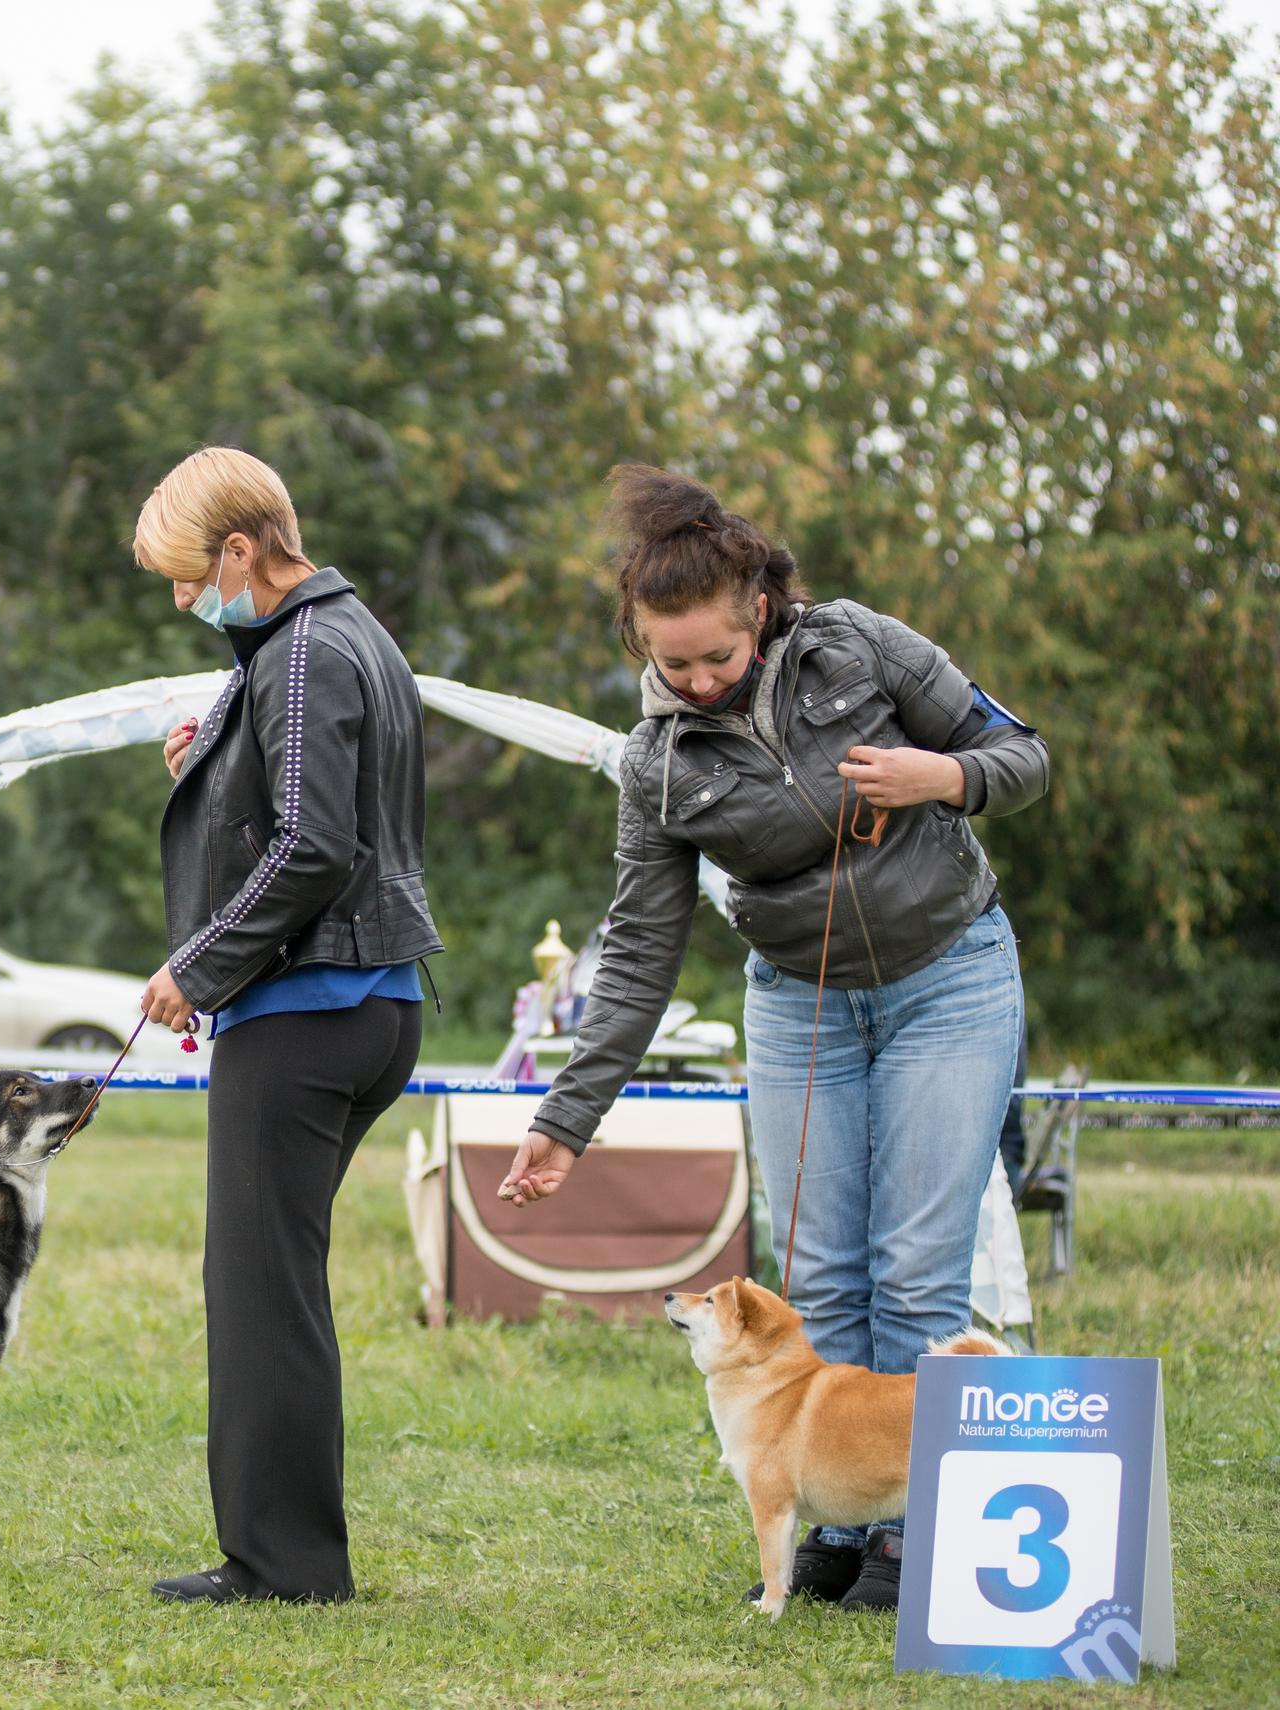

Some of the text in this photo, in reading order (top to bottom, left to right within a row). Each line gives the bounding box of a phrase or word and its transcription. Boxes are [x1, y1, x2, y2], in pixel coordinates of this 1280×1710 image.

[958, 1423, 1108, 1440] Natural Superpremium
[976, 1483, 1071, 1613] 3
